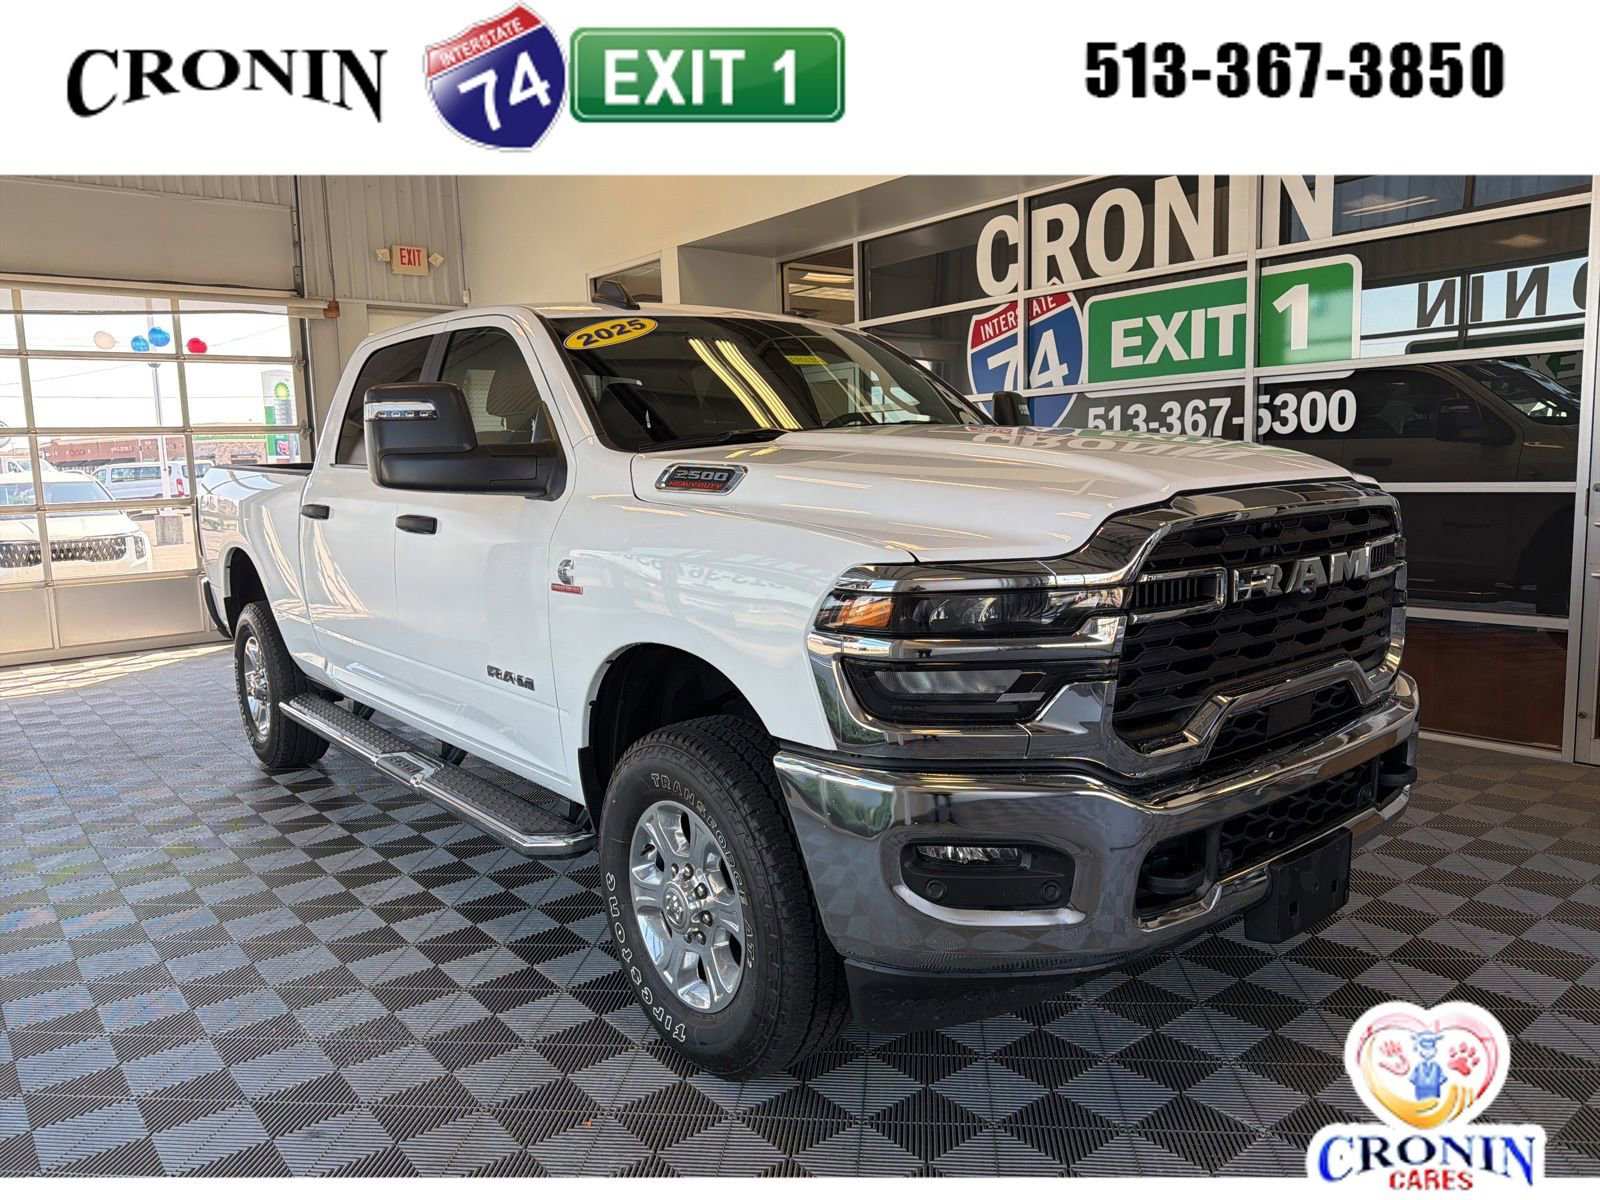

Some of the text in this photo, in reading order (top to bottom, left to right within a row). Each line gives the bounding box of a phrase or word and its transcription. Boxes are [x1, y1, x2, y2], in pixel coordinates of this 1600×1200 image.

[976, 174, 1334, 297] CRONIN
[399, 247, 422, 266] EXIT
[576, 319, 648, 347] 2025
[1111, 284, 1309, 368] EXIT 1
[987, 329, 1069, 391] 74
[669, 480, 696, 488] HEAVY
[673, 470, 729, 481] 2500
[1233, 548, 1369, 602] RAM
[486, 665, 535, 691] RAM
